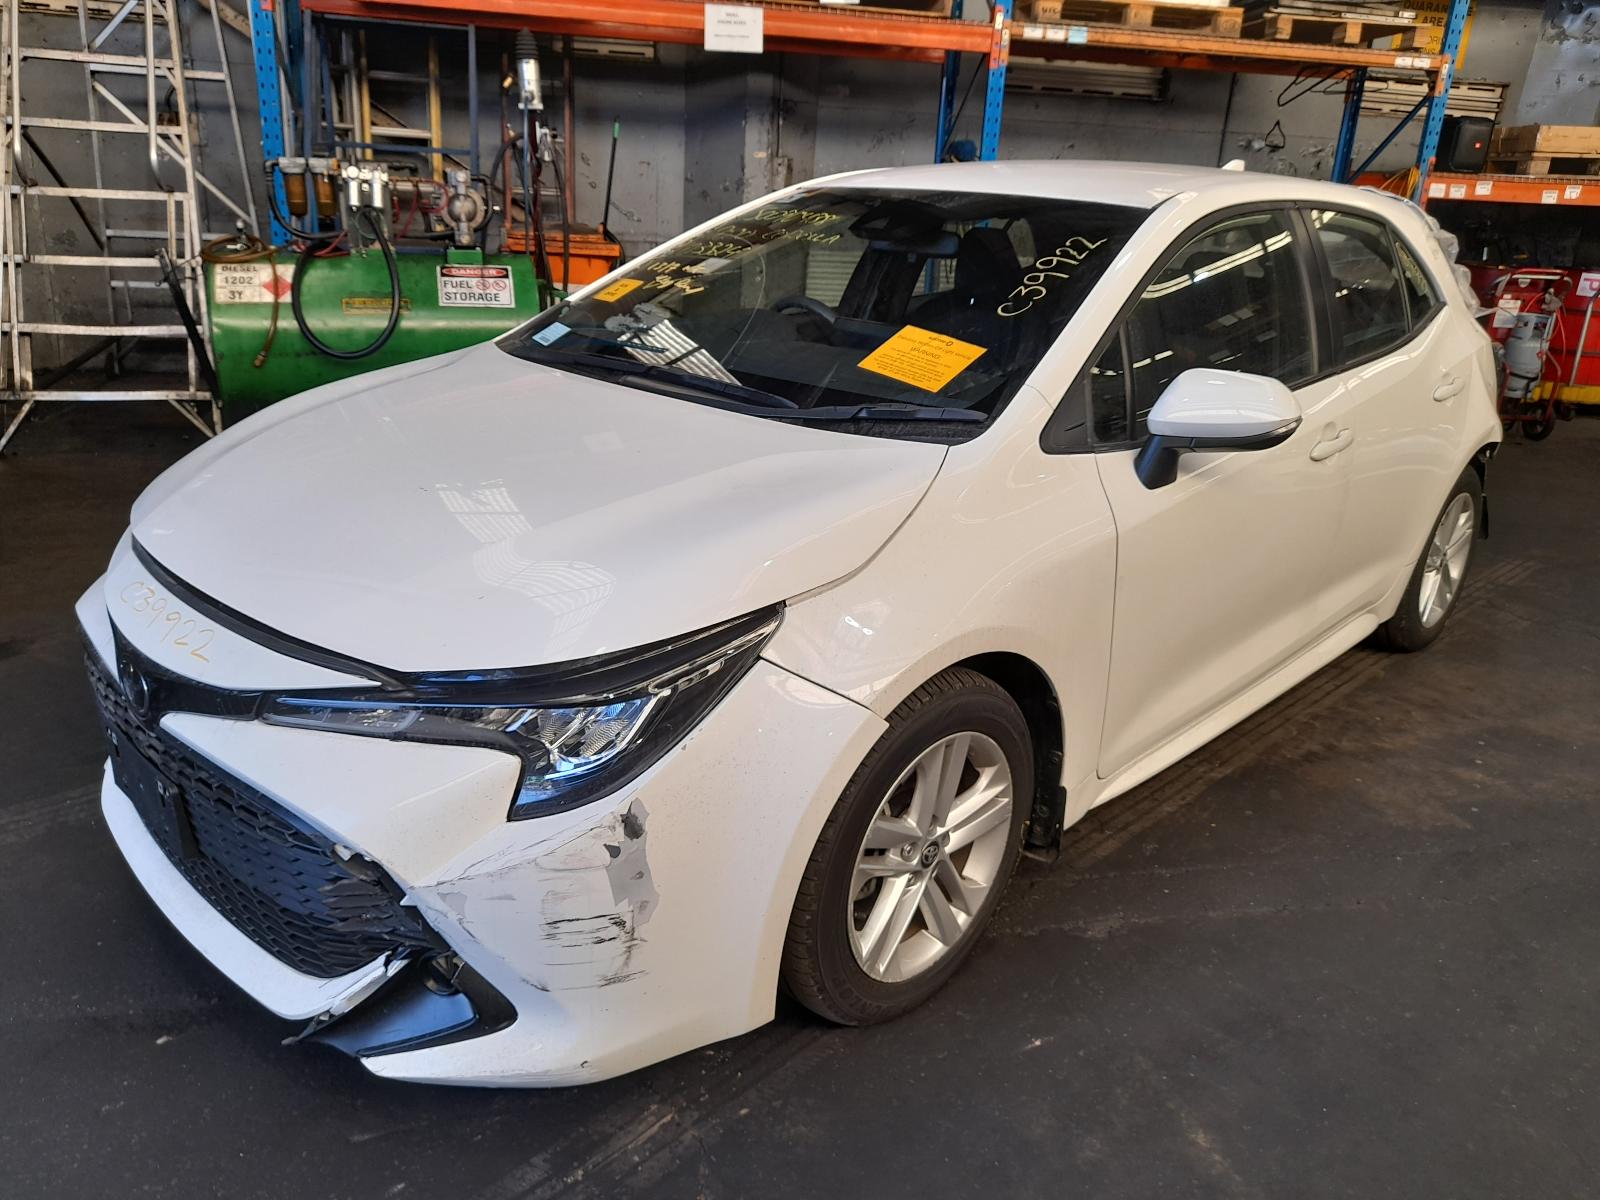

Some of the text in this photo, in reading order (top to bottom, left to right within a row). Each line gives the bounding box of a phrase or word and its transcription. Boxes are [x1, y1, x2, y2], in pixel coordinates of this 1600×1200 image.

[1422, 15, 1445, 27] ARE
[221, 265, 258, 273] DIESEL
[224, 276, 254, 285] 1202
[997, 236, 1107, 316] C39922
[443, 280, 473, 290] FUEL
[228, 290, 244, 300] 3Y
[444, 291, 502, 303] STORAGE
[119, 581, 216, 663] C39922
